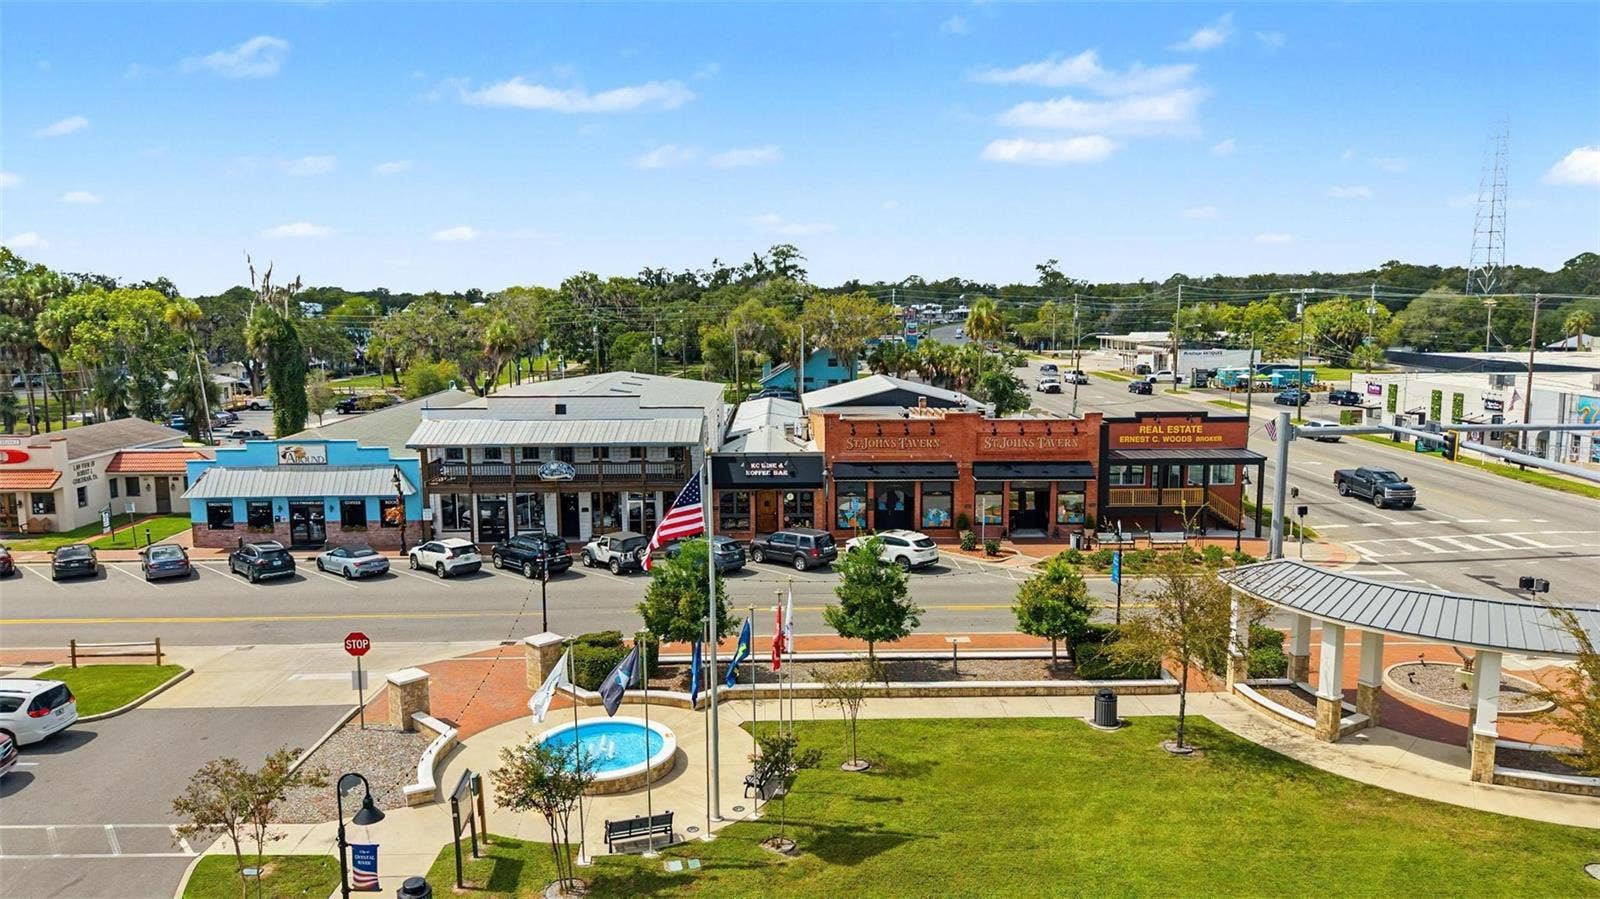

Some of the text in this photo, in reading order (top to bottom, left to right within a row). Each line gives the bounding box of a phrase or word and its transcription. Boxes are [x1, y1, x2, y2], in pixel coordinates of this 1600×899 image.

[1139, 425, 1203, 434] REAL ESTATE
[1119, 435, 1150, 443] ERNEST
[1162, 435, 1193, 443] WOODS
[345, 639, 369, 649] STOP
